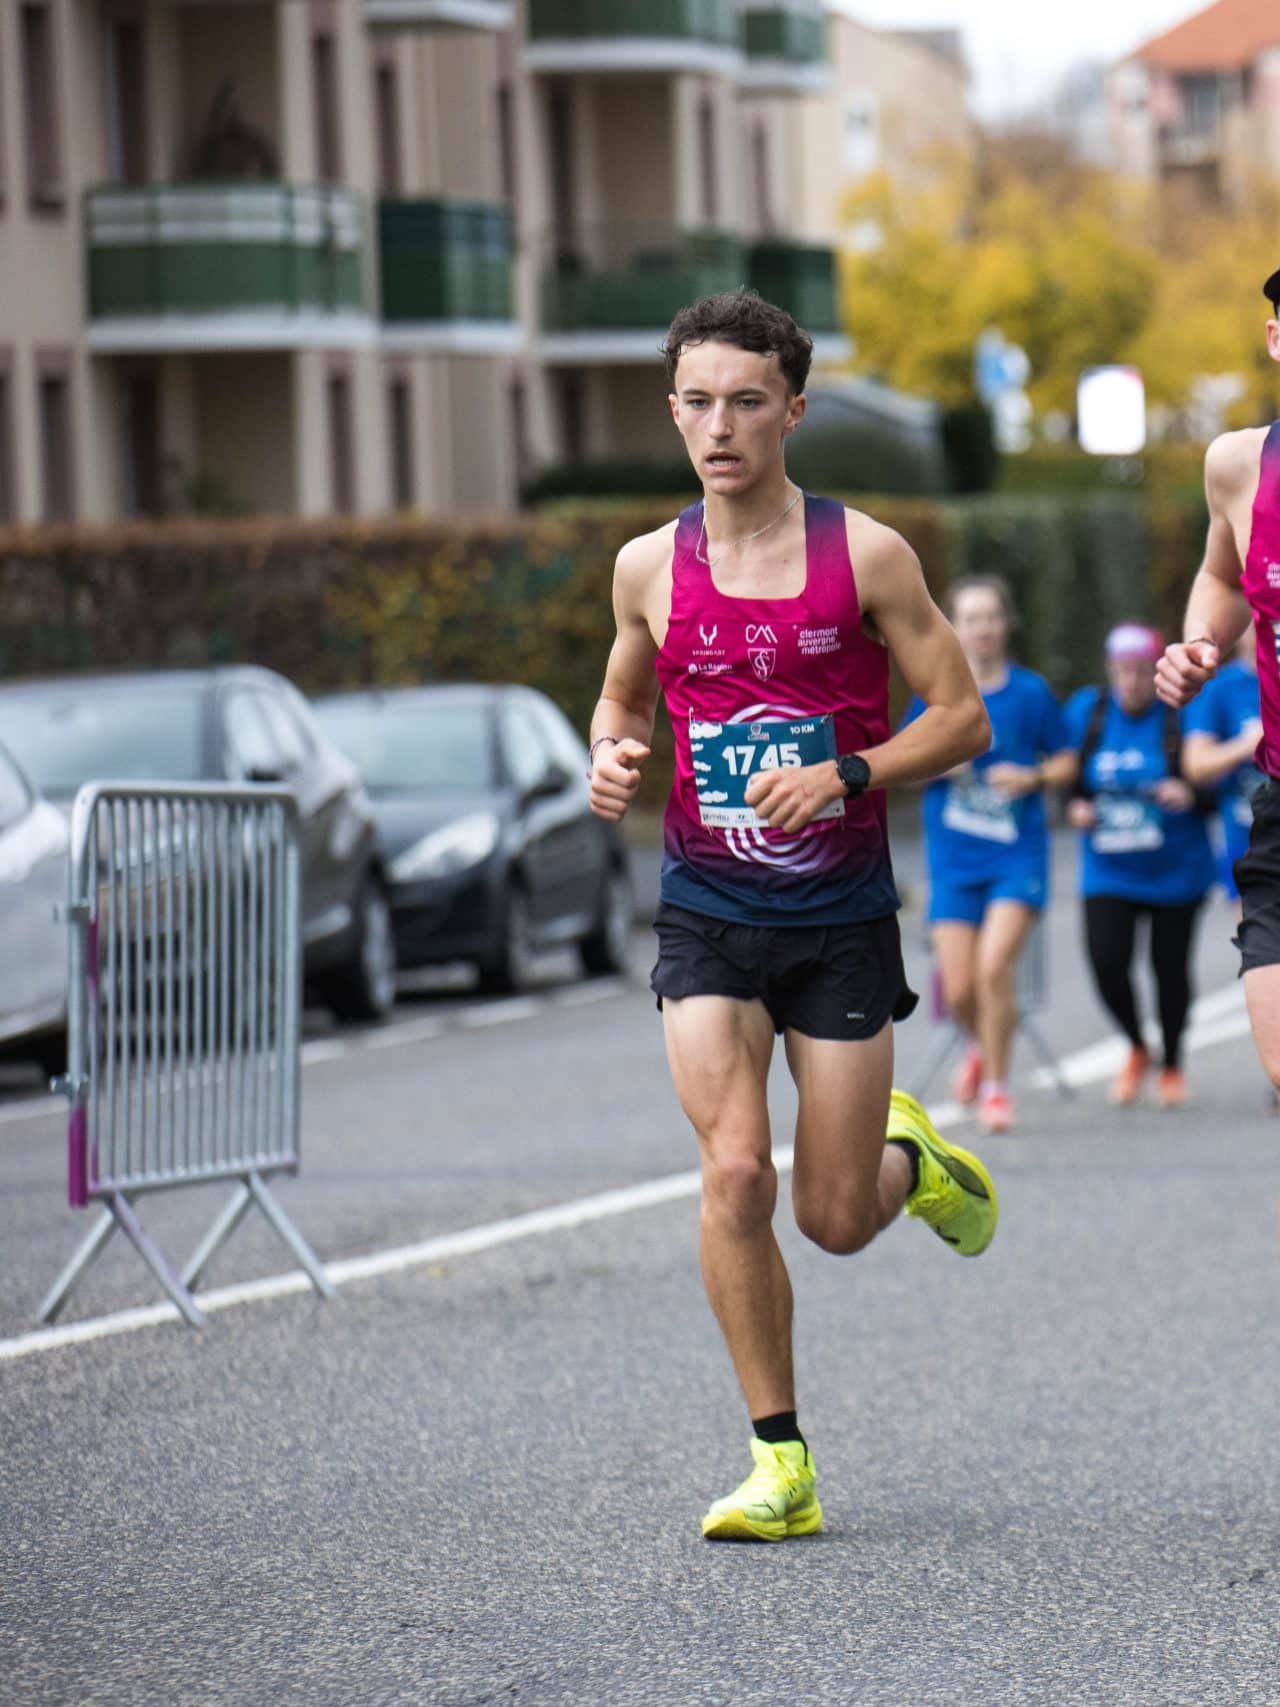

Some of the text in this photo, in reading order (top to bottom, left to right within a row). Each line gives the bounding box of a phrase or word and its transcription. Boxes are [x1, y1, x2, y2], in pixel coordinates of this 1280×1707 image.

[799, 626, 838, 639] clermont
[790, 724, 815, 735] 10 KM
[721, 742, 802, 776] 1745
